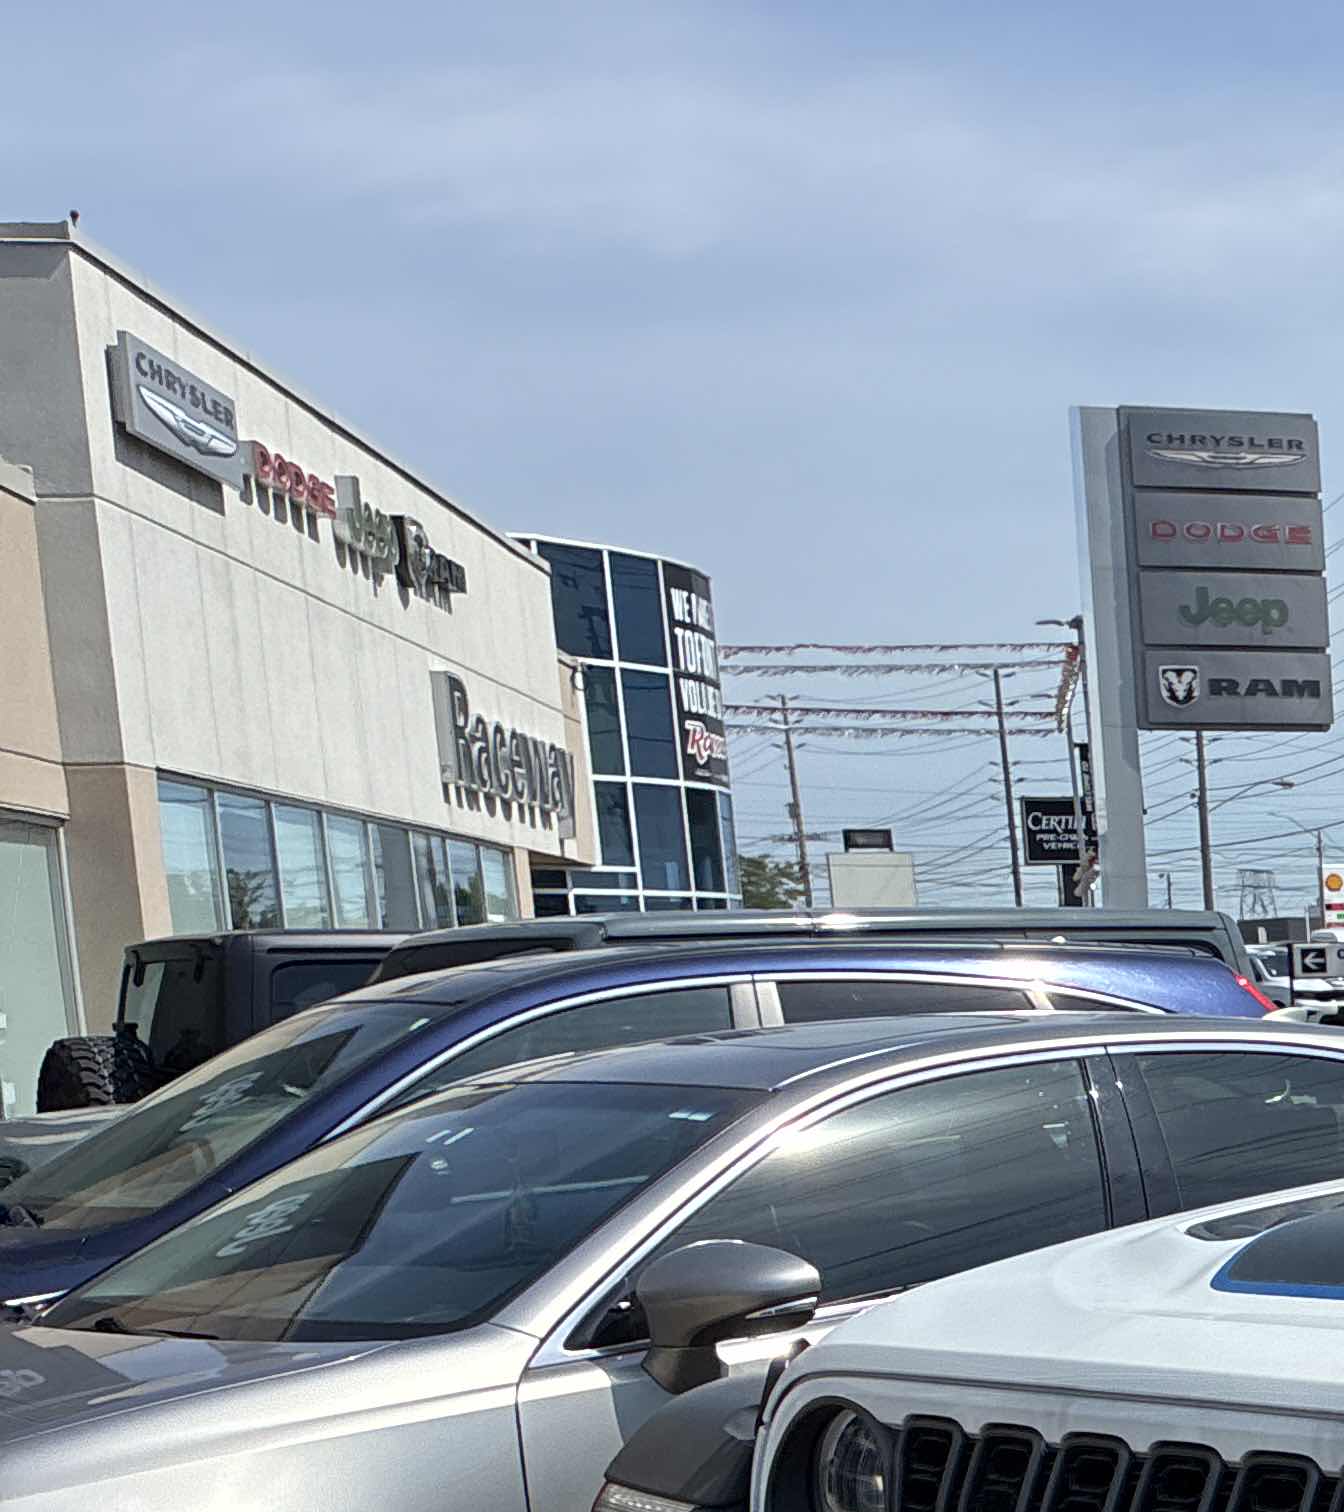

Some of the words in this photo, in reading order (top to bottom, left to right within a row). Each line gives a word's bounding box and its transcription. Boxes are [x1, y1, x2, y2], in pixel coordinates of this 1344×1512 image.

[135, 351, 235, 430] CHRYSLER
[1146, 432, 1305, 451] CHRYSLER
[1150, 520, 1313, 546] DODGE
[1178, 586, 1290, 635] Jeep
[1207, 678, 1321, 699] RAM
[430, 671, 576, 838] Raceway
